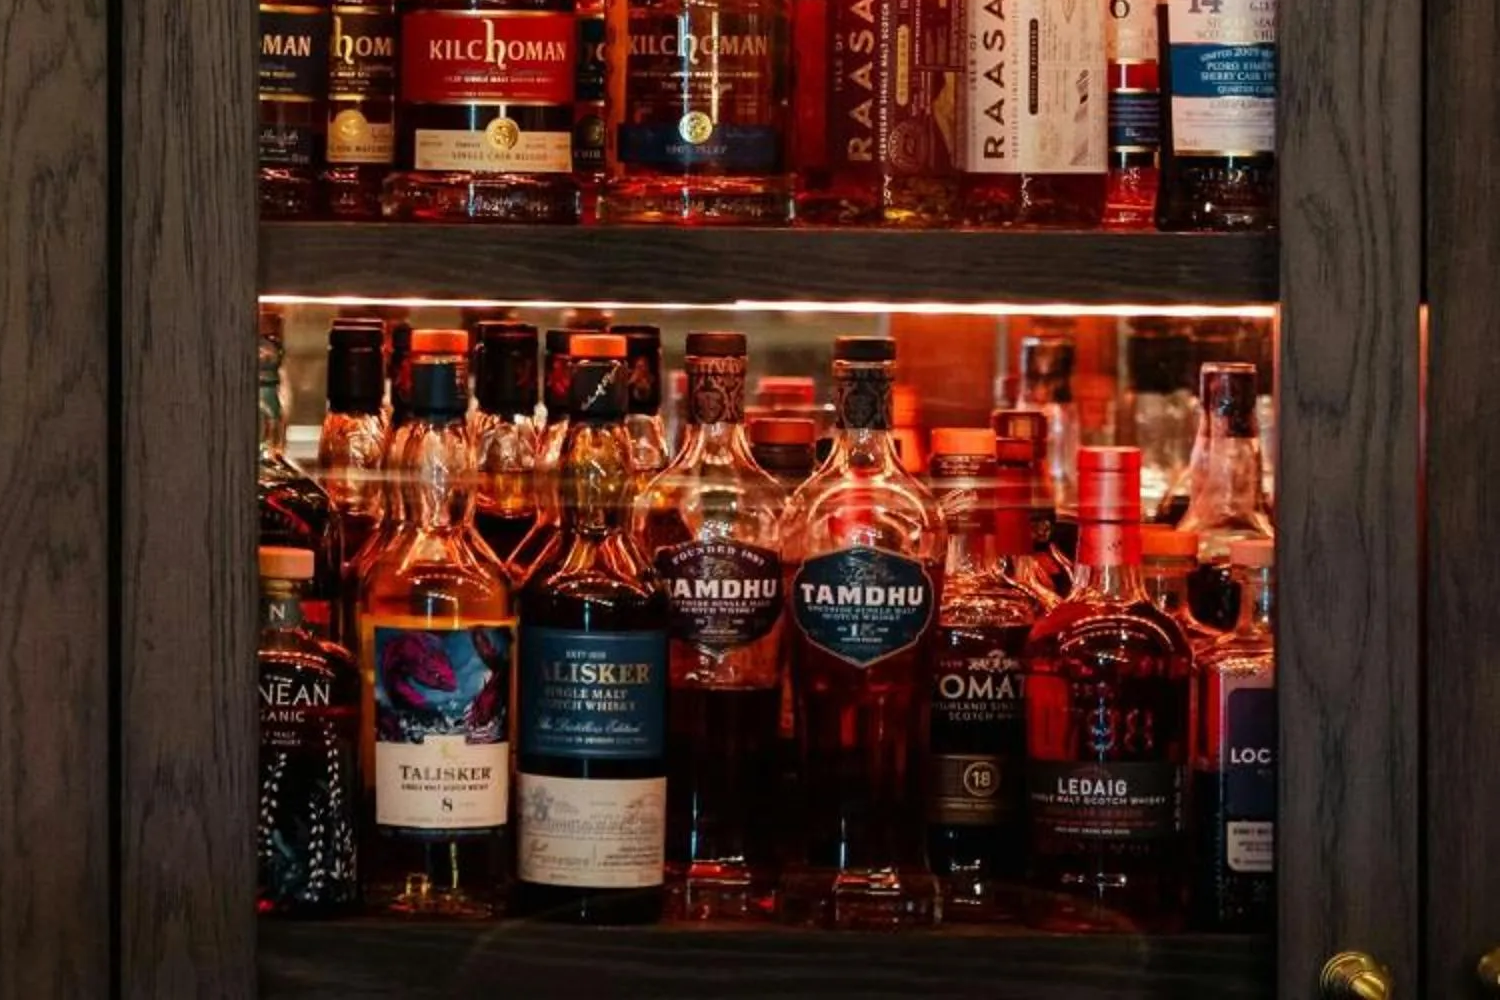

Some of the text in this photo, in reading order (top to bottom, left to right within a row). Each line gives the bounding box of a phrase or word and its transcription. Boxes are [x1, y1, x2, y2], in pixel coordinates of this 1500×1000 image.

[667, 579, 777, 599] AMDHU
[800, 583, 924, 606] TAMDHU
[398, 764, 493, 781] TALISKER
[971, 771, 991, 787] 18
[1057, 777, 1128, 796] LEDAIG
